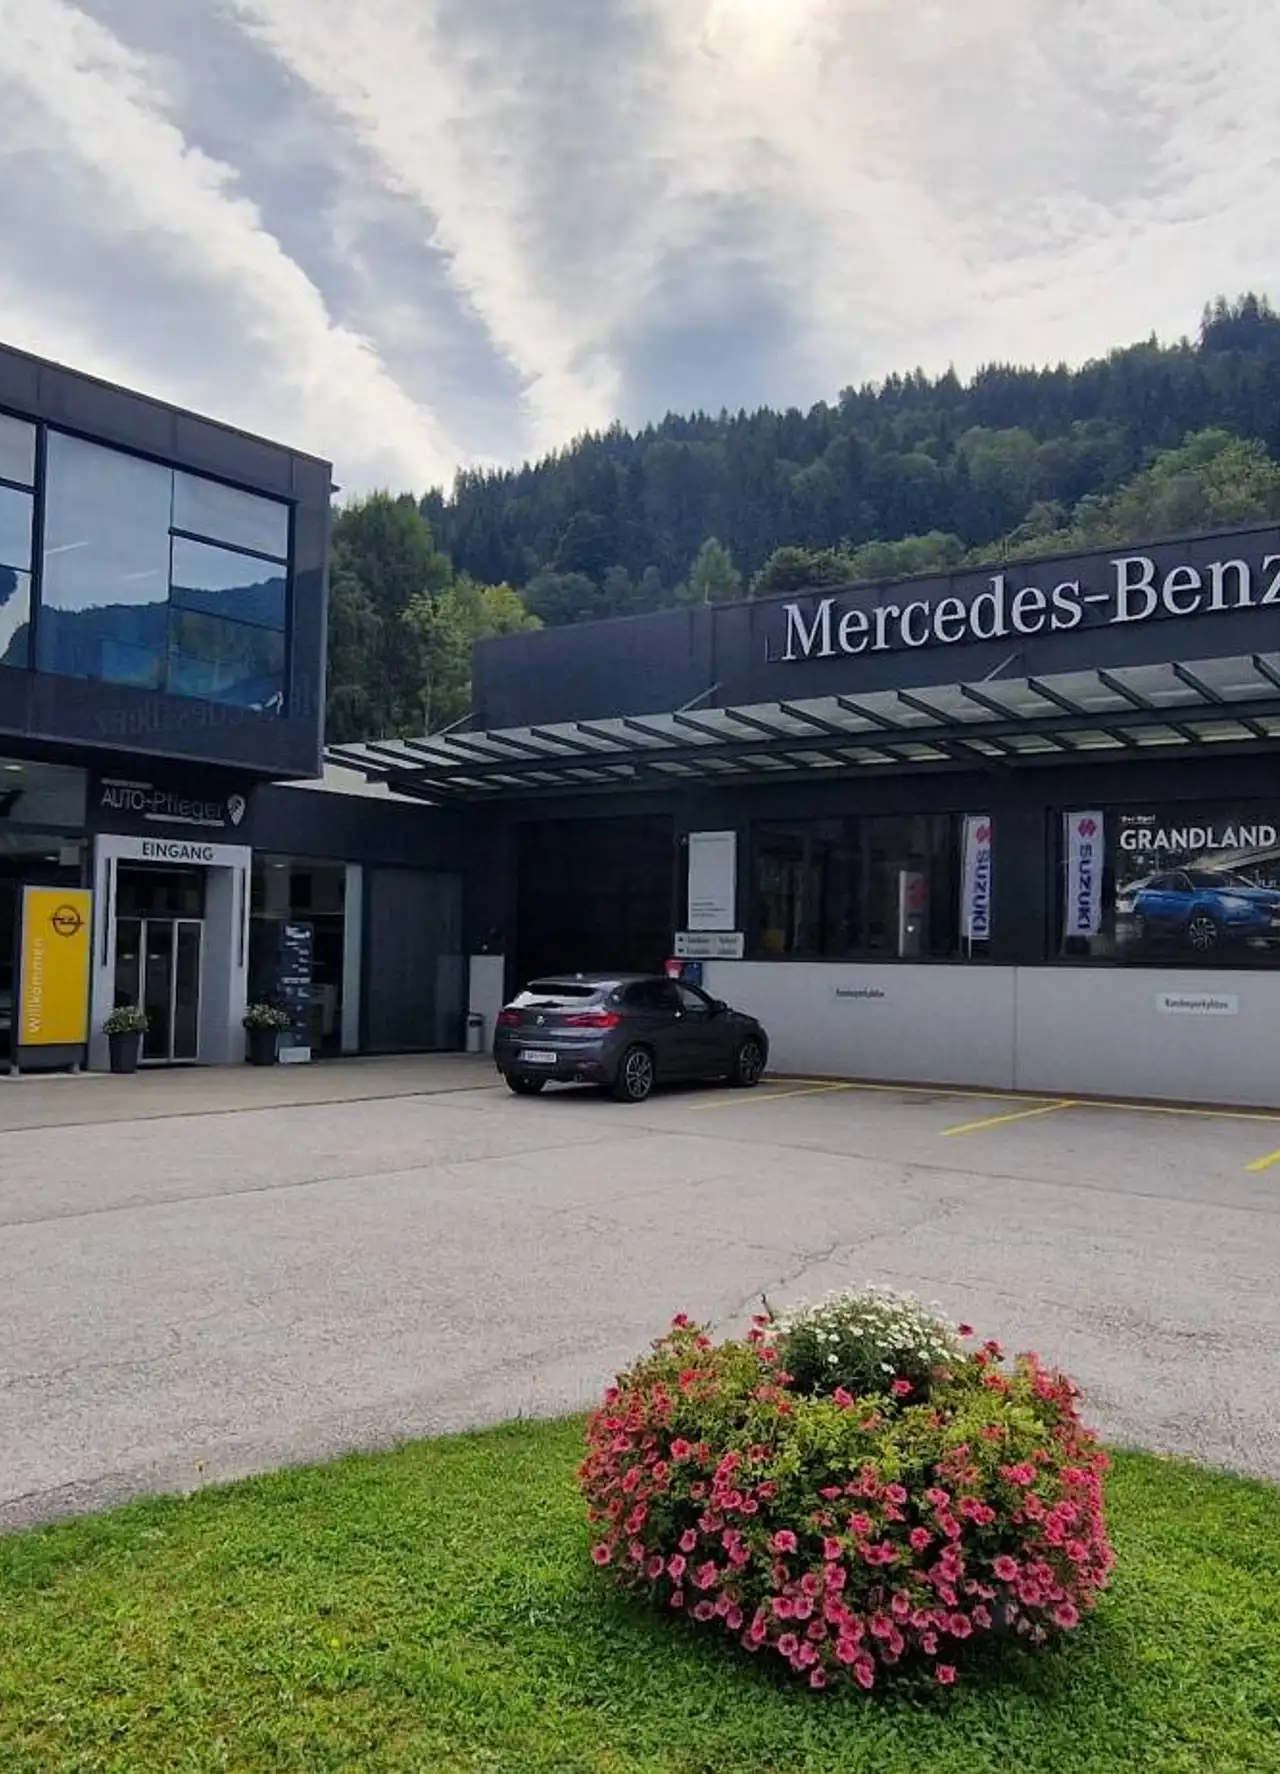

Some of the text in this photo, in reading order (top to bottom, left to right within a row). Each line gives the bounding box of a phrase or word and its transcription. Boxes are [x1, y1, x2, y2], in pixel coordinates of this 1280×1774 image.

[142, 841, 214, 861] EINGANG
[1120, 825, 1277, 850] GRANDLAND
[972, 850, 990, 932] SUZUKI
[1077, 843, 1093, 930] SUZUKI
